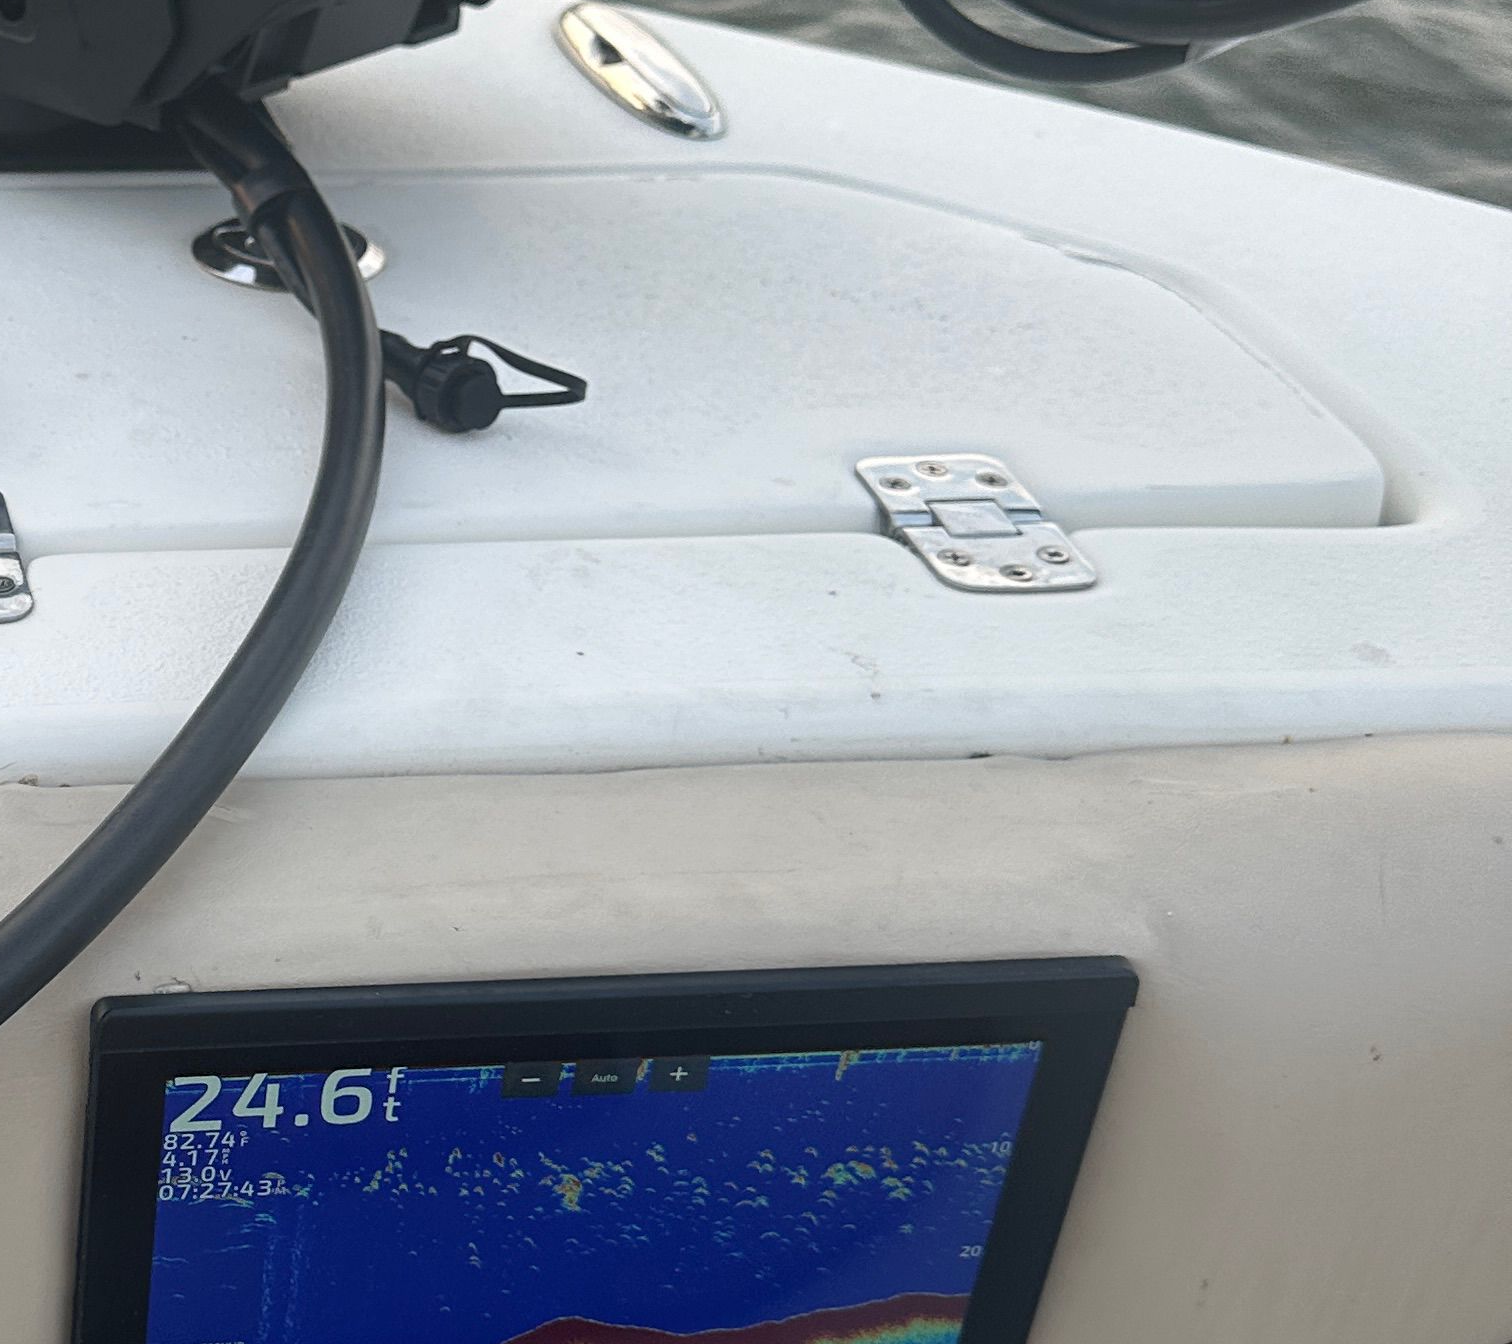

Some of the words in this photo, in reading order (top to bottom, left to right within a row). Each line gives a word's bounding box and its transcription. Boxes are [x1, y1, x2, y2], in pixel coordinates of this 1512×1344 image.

[591, 1073, 619, 1083] Auto
[169, 1067, 373, 1133] 24.6
[163, 1131, 236, 1150] 82.74
[990, 1140, 1013, 1154] 10
[162, 1149, 219, 1167] 4.17
[158, 1179, 273, 1201] 07:27:43
[959, 1245, 983, 1258] 20
